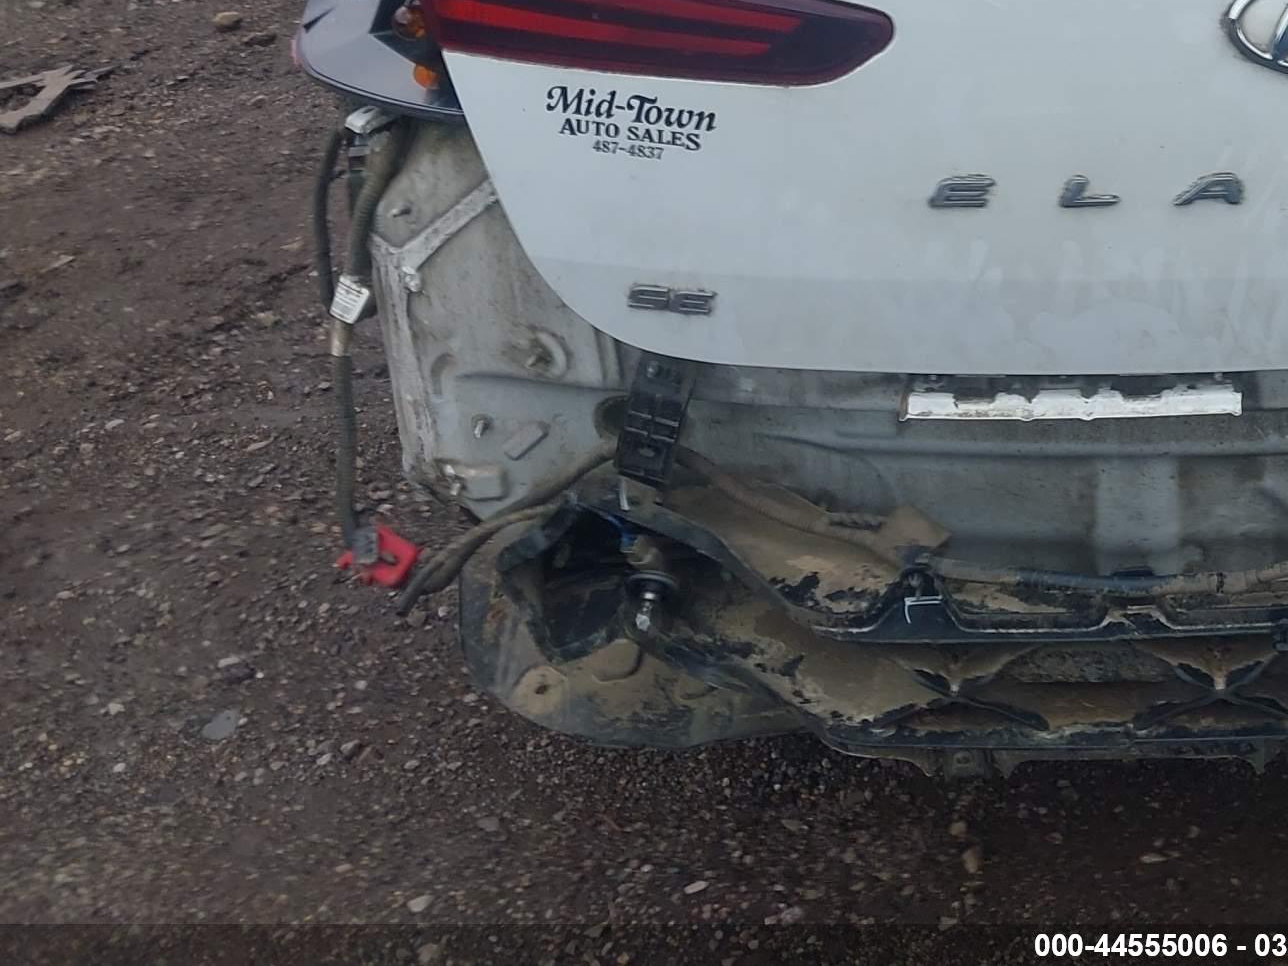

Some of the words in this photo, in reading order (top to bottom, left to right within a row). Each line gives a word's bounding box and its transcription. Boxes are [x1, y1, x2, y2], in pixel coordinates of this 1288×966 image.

[546, 86, 717, 132] Mid-Town
[559, 118, 621, 139] AUTO
[627, 126, 702, 152] SALES
[592, 139, 665, 160] 487-4837
[627, 283, 717, 316] SE
